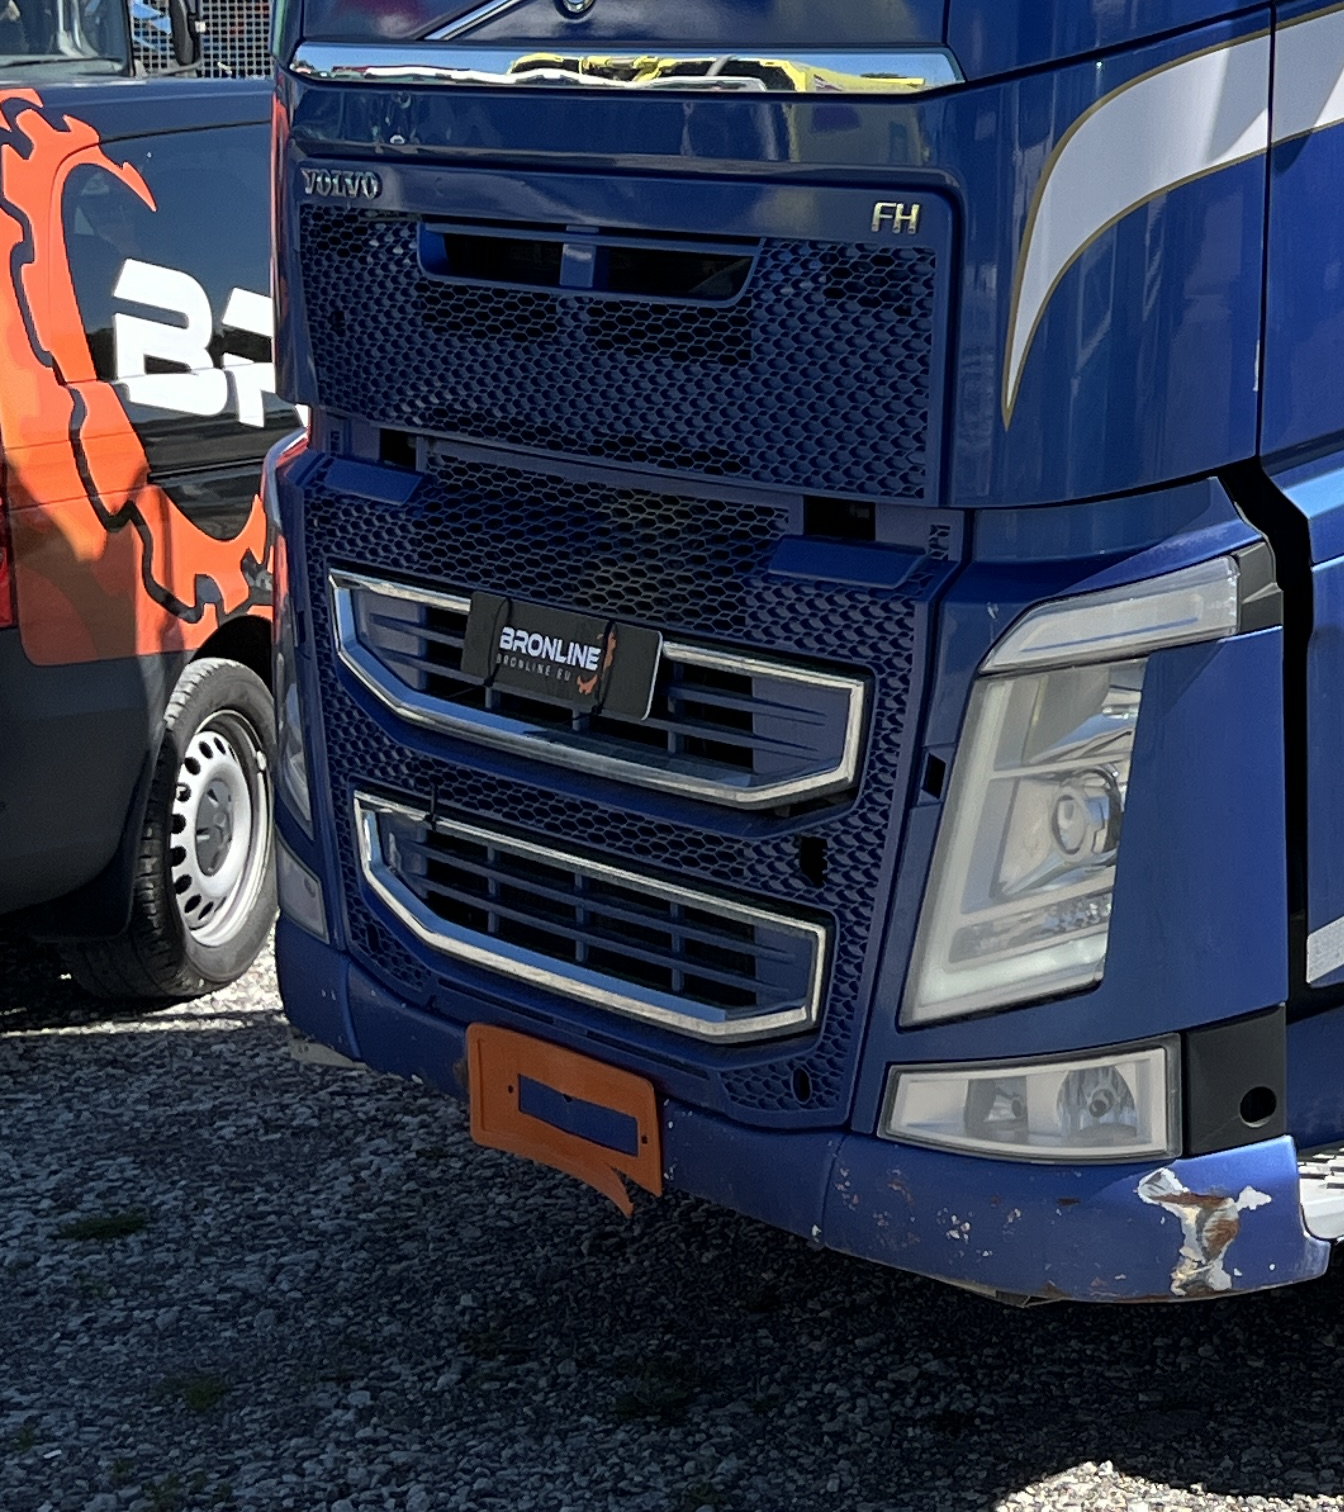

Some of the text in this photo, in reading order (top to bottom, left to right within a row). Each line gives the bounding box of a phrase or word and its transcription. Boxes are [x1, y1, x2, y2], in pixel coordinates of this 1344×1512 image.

[301, 168, 381, 199] VOLVO
[871, 201, 920, 234] FH
[499, 626, 602, 670] BRONLINE
[496, 652, 571, 682] BRONLINE EU
